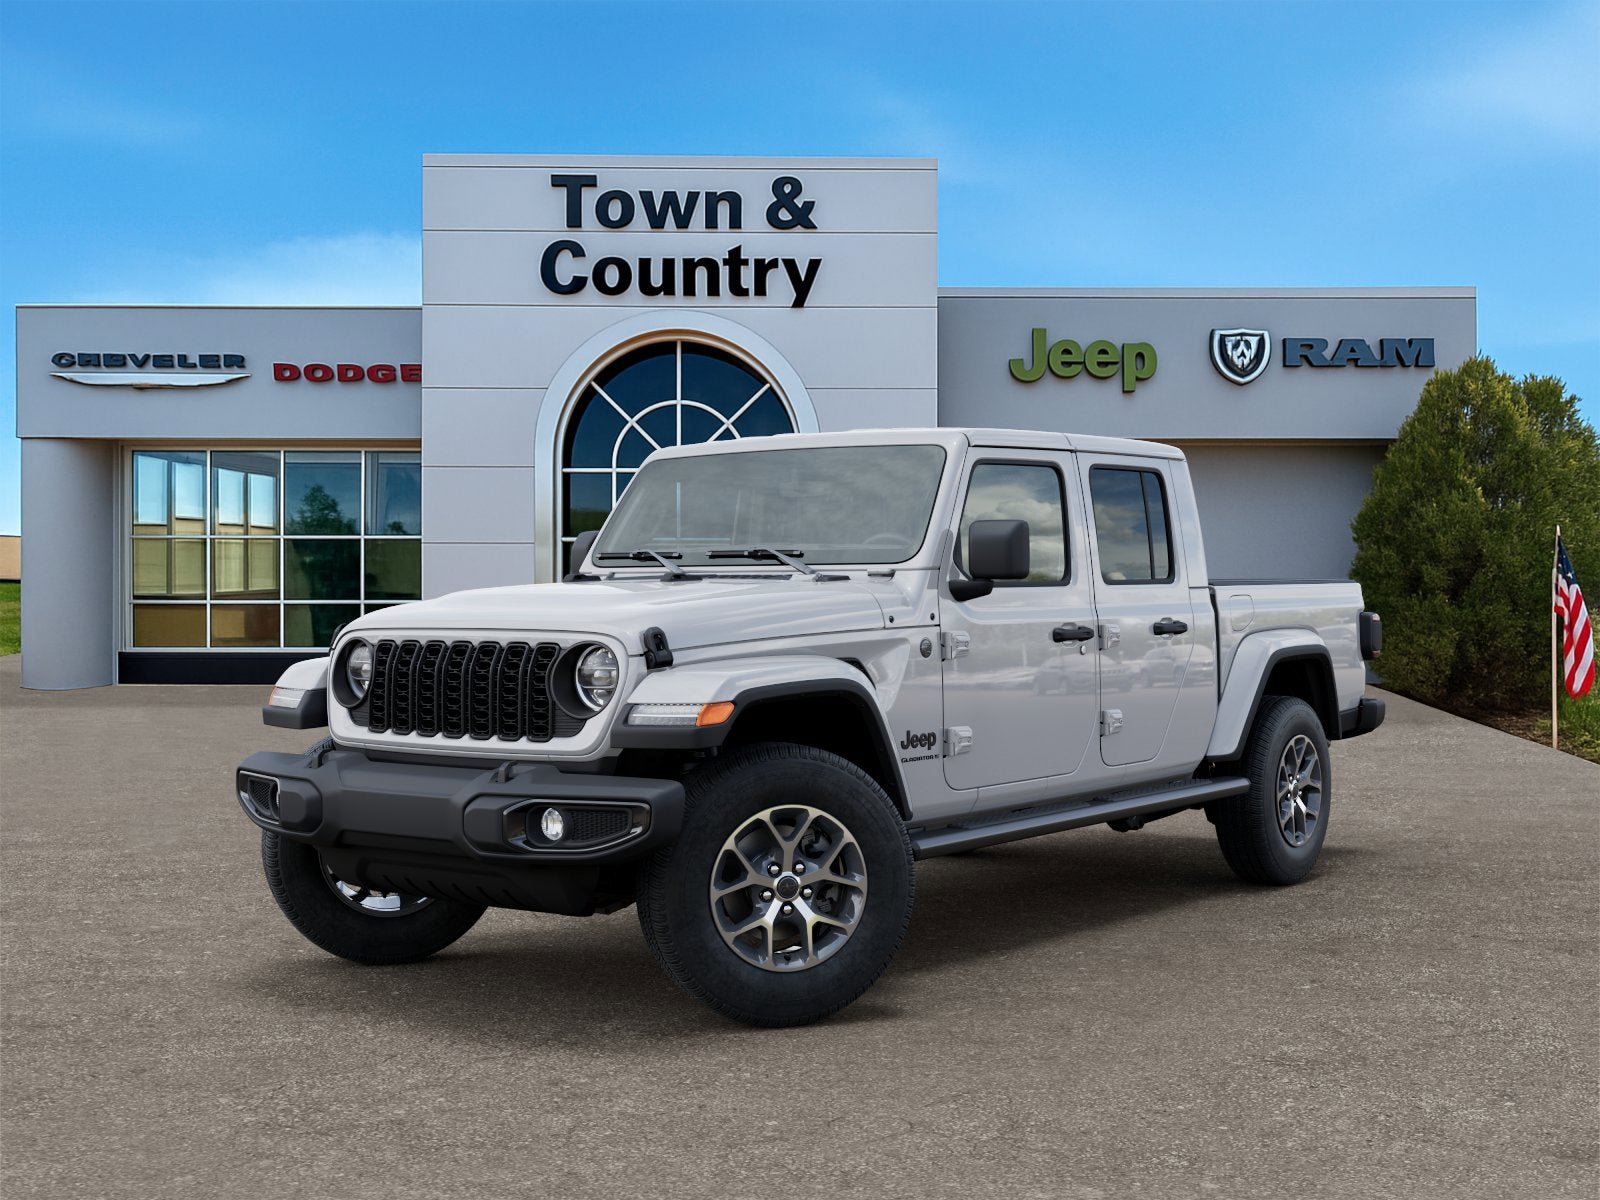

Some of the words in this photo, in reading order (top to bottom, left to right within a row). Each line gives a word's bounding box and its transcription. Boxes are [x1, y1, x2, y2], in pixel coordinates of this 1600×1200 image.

[551, 174, 742, 231] Town
[766, 176, 818, 231] &
[540, 240, 822, 309] Country
[273, 363, 422, 383] DODGE
[1009, 328, 1157, 393] Jeep
[1282, 337, 1436, 368] RAM
[901, 730, 937, 750] Jeep
